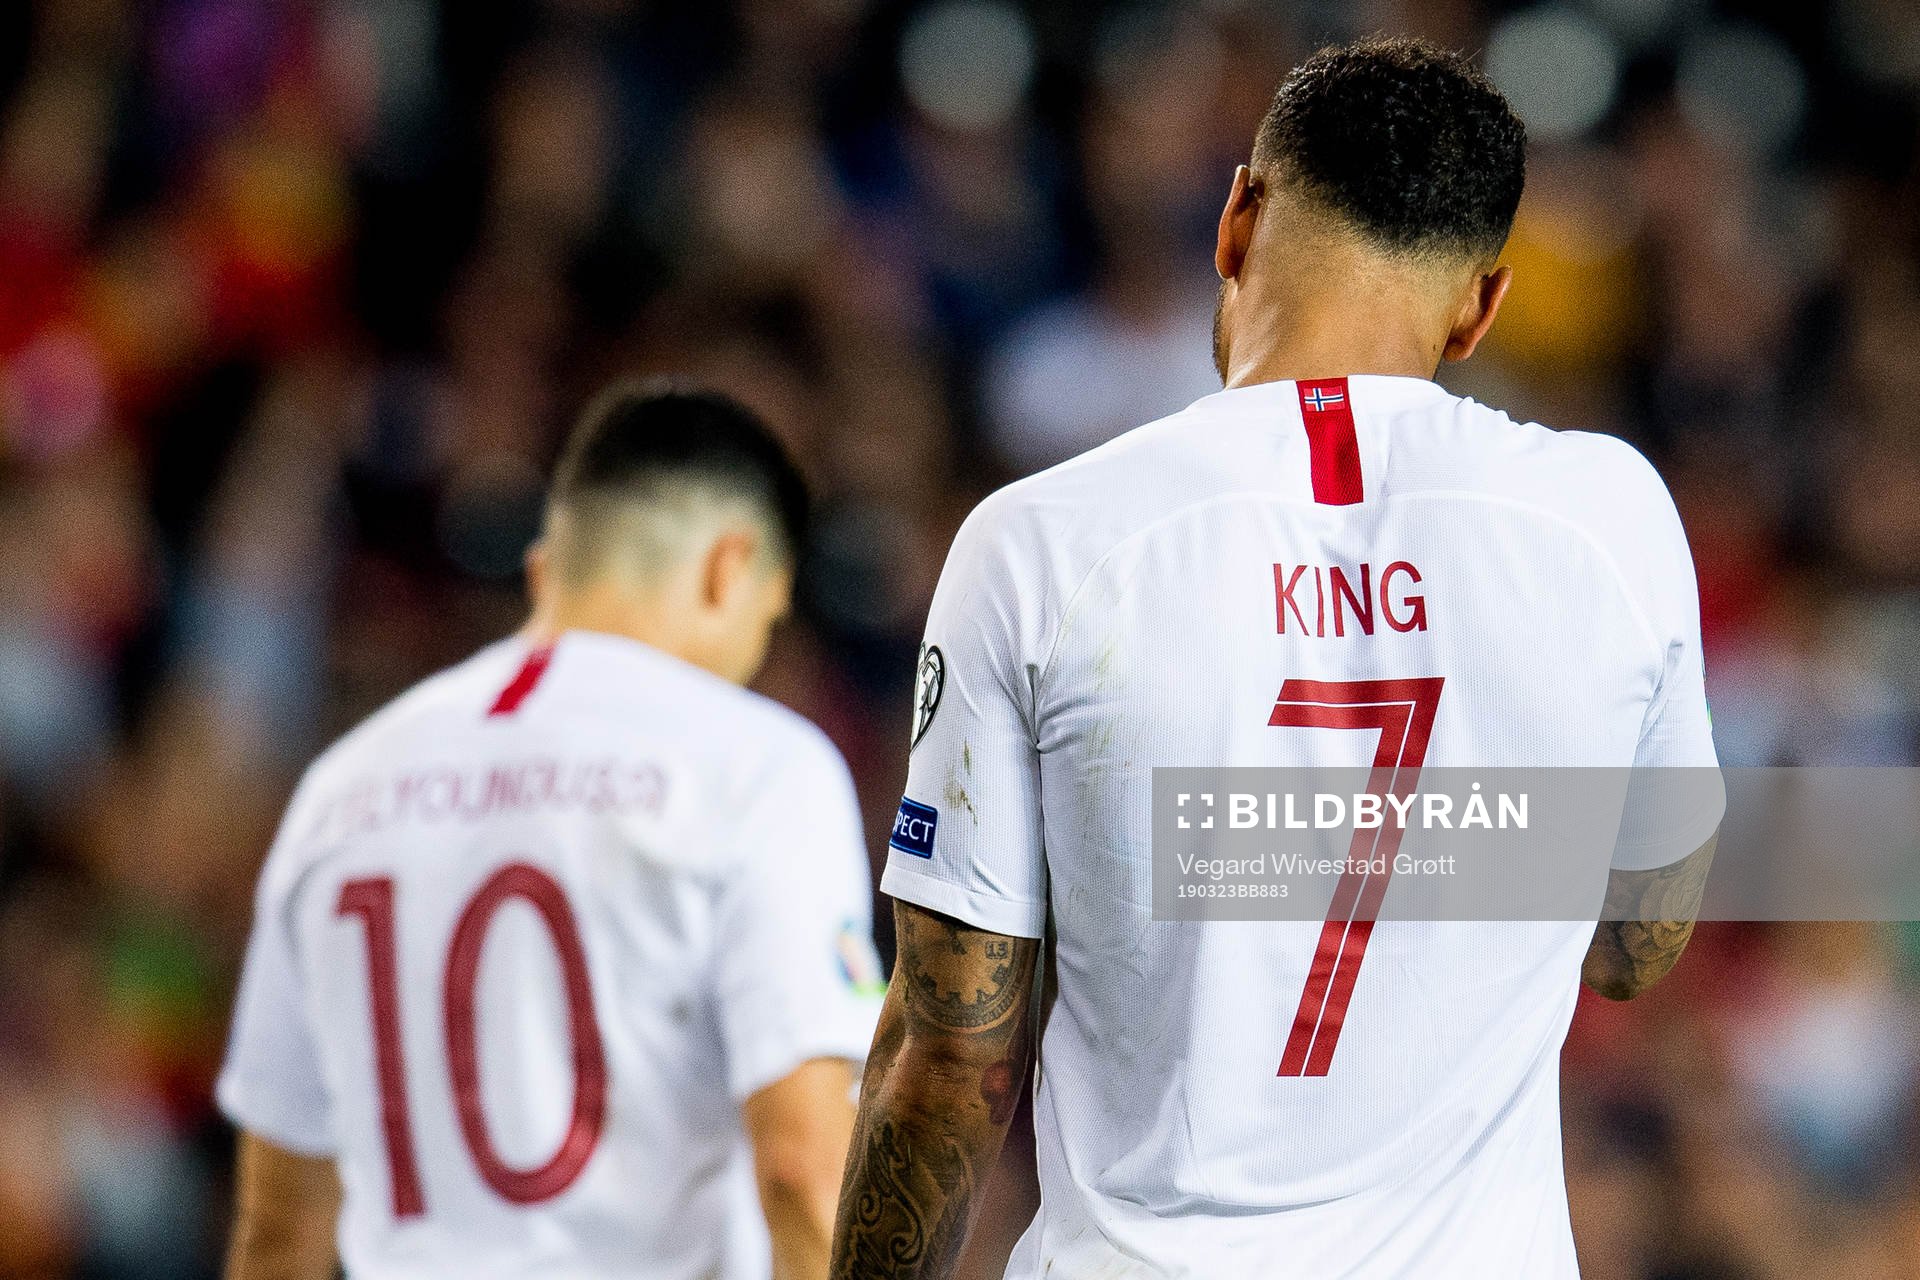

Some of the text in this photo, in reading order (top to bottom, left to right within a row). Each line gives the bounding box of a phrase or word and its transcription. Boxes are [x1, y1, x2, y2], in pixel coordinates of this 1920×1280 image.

[1273, 561, 1428, 638] KING
[335, 862, 609, 1220] 10
[1267, 677, 1446, 1077] 7
